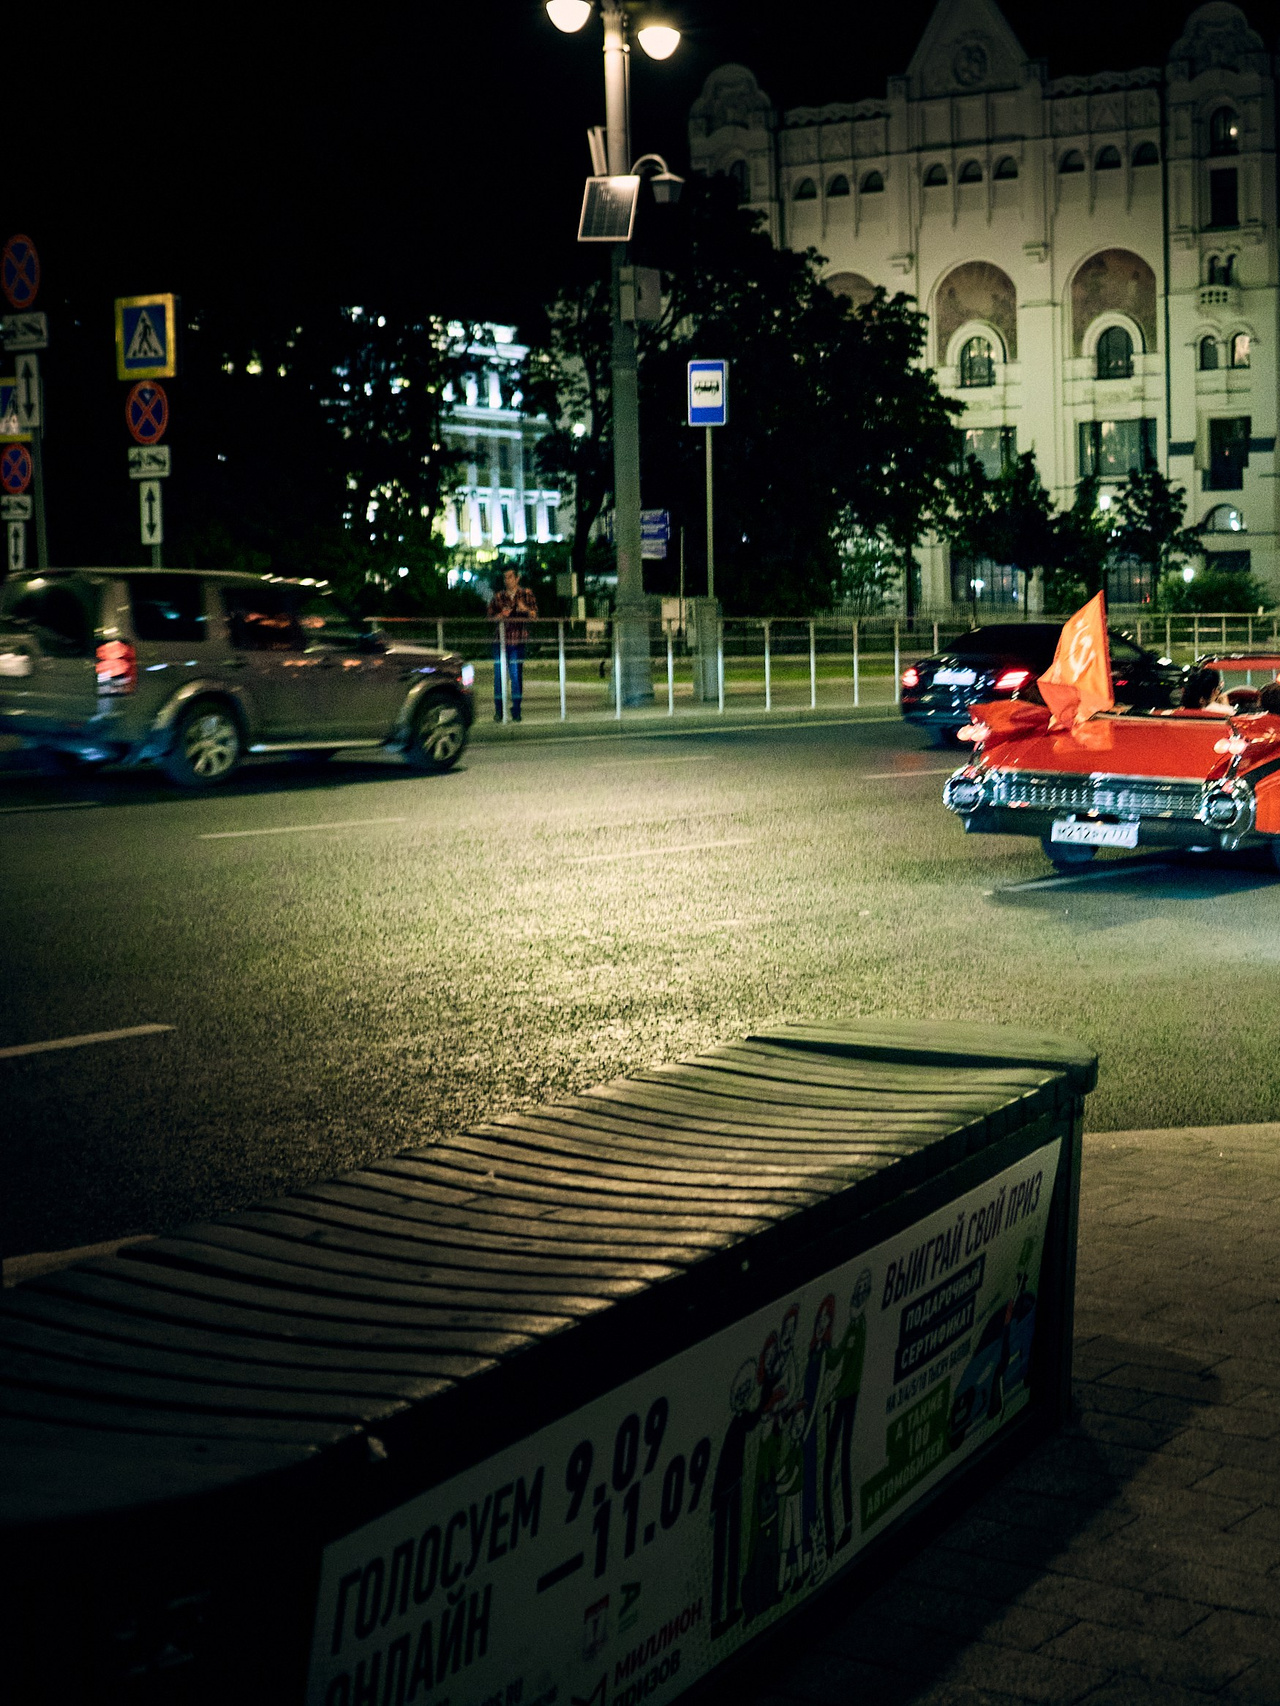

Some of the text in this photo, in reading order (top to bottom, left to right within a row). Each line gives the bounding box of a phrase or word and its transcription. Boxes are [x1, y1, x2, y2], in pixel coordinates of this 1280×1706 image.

[881, 1170, 1043, 1311] ВЫИГРАЙ СВОЙ ПРИЗ
[900, 1301, 974, 1370] СЕРТИФИКАТ
[905, 1259, 982, 1334] ПОДАРОЧНЫЙ
[564, 1396, 669, 1525] 9.09
[865, 1432, 945, 1520] АВТОМОБИЛЕЙ
[331, 1465, 545, 1656] ГОЛОСУЕМ
[614, 1597, 703, 1687] МИЛЛИОН
